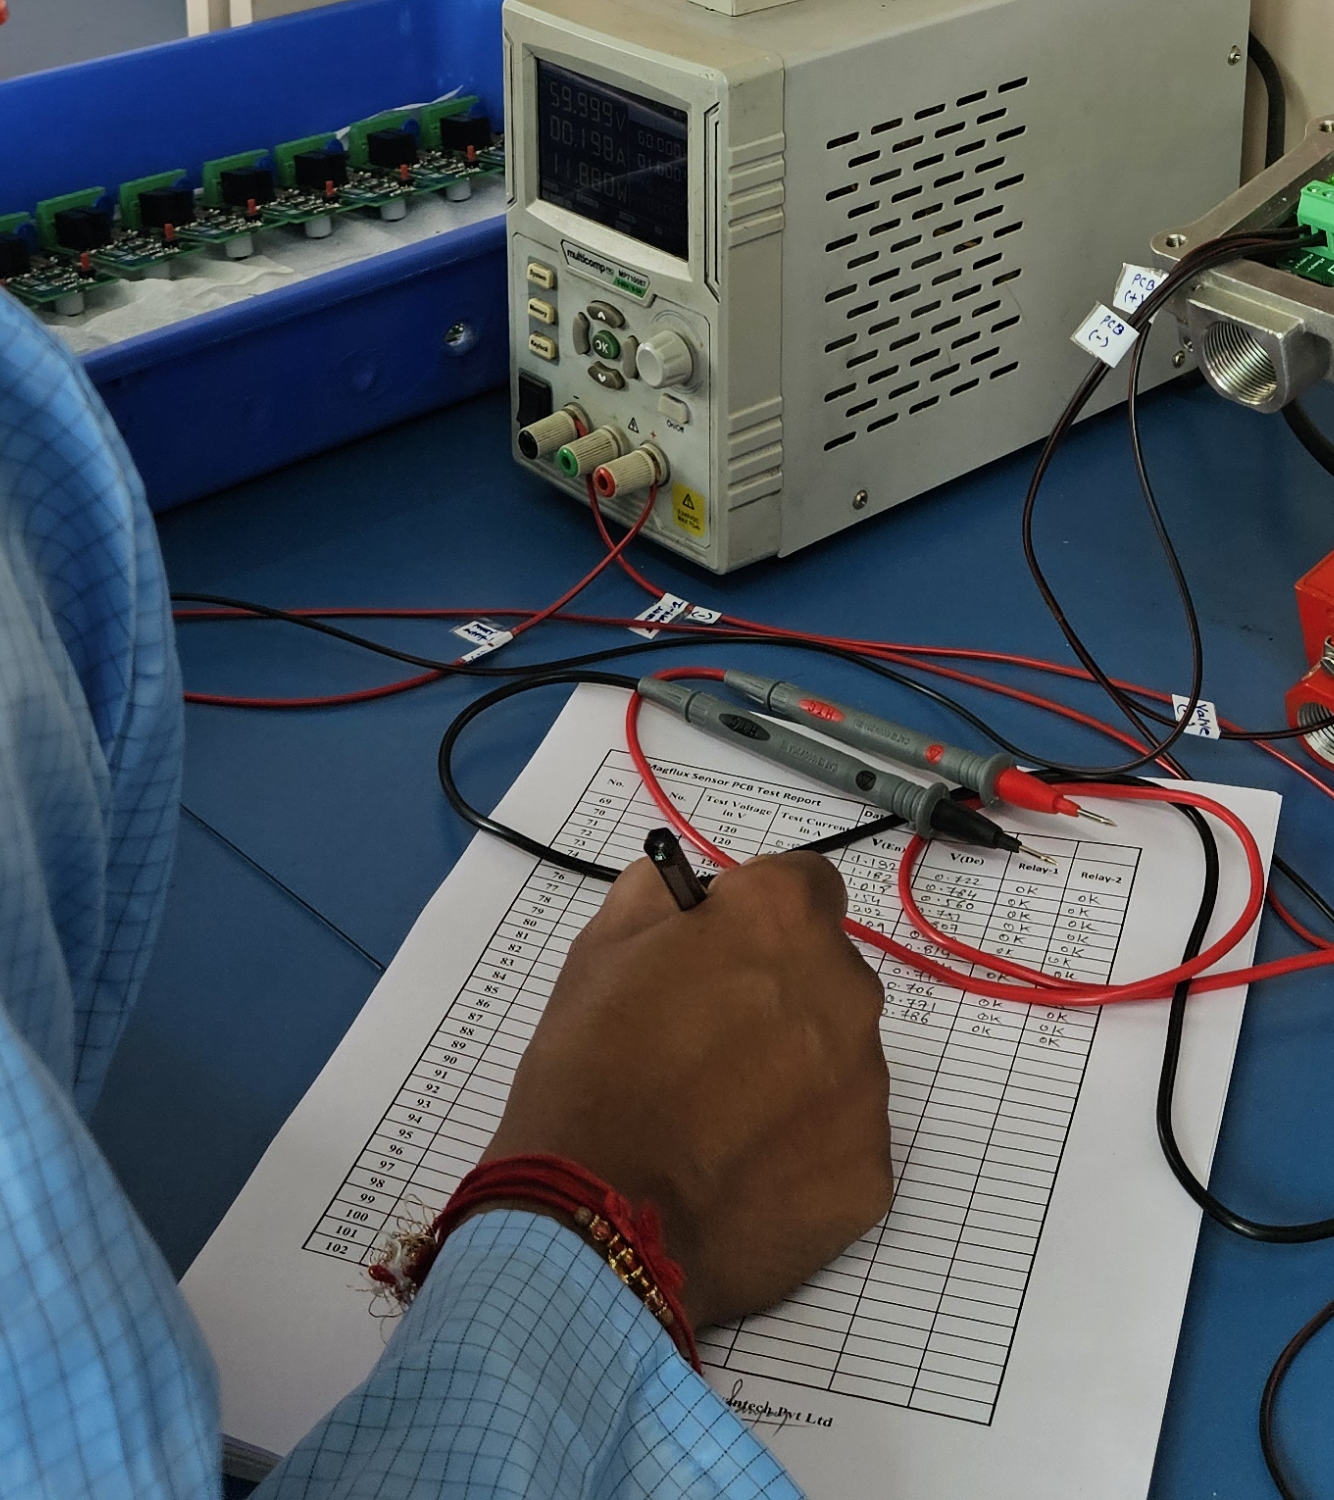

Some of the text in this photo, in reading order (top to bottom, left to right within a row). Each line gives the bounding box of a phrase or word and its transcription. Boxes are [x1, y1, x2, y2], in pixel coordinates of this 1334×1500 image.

[567, 249, 606, 274] multicomp
[1132, 273, 1155, 291] PCB
[1100, 315, 1125, 336] PCB
[595, 339, 609, 353] OK
[607, 778, 624, 788] No.
[691, 772, 730, 787] Sensor
[732, 781, 754, 792] PCB
[757, 786, 781, 798] Test
[783, 792, 822, 807] Report
[668, 791, 687, 802] No.
[599, 798, 612, 806] 69
[706, 794, 773, 816] Test Voltage
[593, 808, 606, 816] 70
[722, 809, 733, 817] in
[780, 812, 803, 823] Test
[586, 819, 598, 827] 71
[580, 828, 593, 837] 72
[718, 824, 737, 834] 120
[799, 826, 822, 837] in A
[574, 839, 586, 847] 73
[712, 836, 732, 846] 120
[872, 837, 906, 854] V(En)
[567, 850, 579, 858] 74
[1018, 862, 1060, 876] Relay-1
[553, 871, 565, 880] 76
[1081, 871, 1123, 885] Relay-2
[546, 883, 559, 892] 77
[538, 894, 552, 904] 78
[531, 906, 544, 915] 79
[522, 918, 537, 927] 80
[515, 931, 529, 940] 81
[507, 943, 522, 953] 82
[500, 957, 514, 967] 83
[492, 971, 507, 980] 84
[484, 985, 500, 994] 85
[476, 999, 490, 1008] 86
[467, 1012, 483, 1022] 87
[459, 1026, 475, 1036] 88
[450, 1040, 467, 1050] 89
[443, 1054, 457, 1064] 90
[434, 1069, 448, 1079] 91
[425, 1083, 440, 1094] 92
[417, 1098, 431, 1109] 93
[407, 1113, 422, 1124] 94
[398, 1128, 414, 1139] 95
[389, 1144, 404, 1155] 96
[379, 1160, 395, 1172] 97
[370, 1177, 385, 1188] 98
[360, 1193, 376, 1204] 99
[345, 1209, 369, 1221] 100
[336, 1225, 358, 1238] 101
[325, 1241, 348, 1254] 102
[806, 1411, 833, 1429] Ltd
